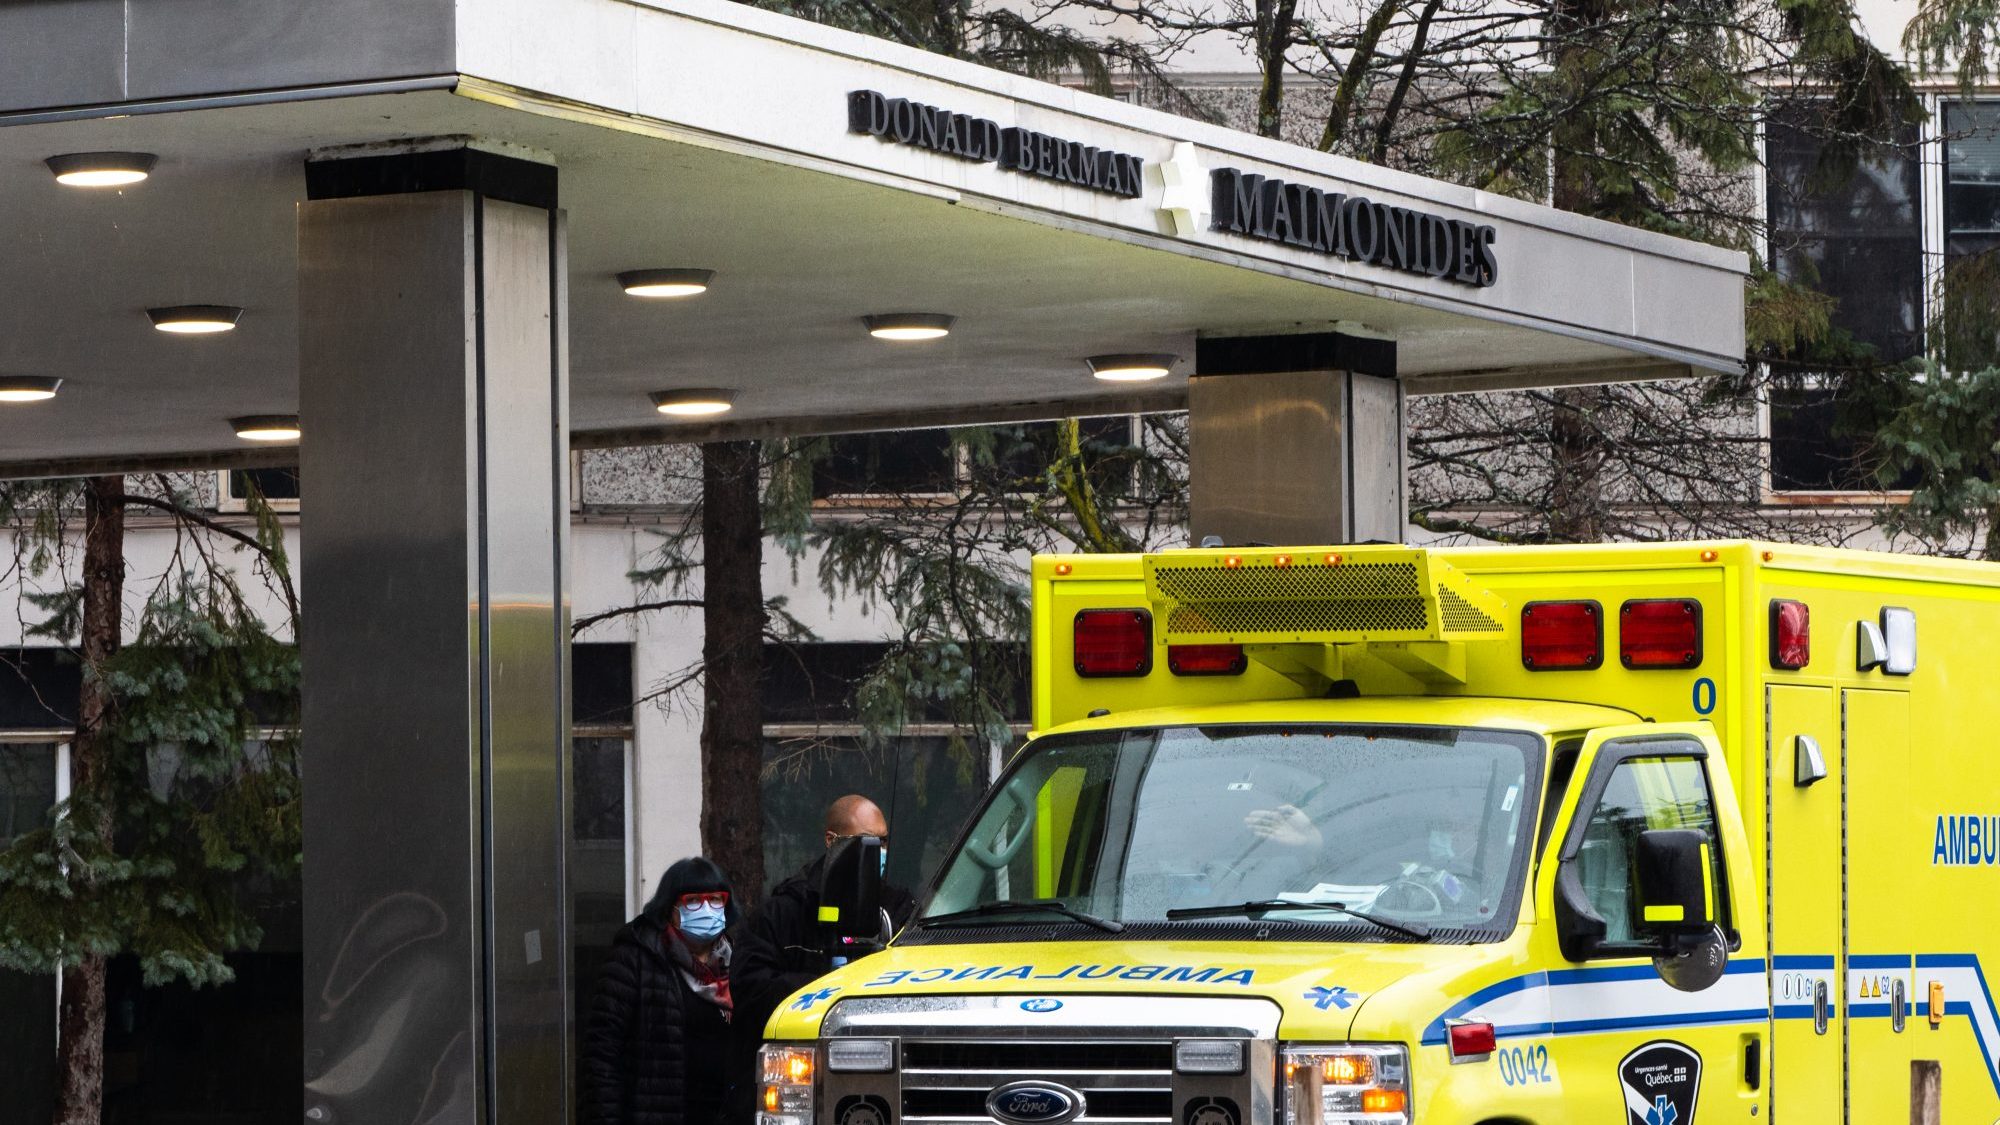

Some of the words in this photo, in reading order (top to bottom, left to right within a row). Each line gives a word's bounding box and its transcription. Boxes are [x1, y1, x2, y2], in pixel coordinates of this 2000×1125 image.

[849, 89, 1000, 162] DONALD
[1001, 127, 1144, 198] BERMAN
[1209, 168, 1498, 287] MAIMONIDES
[1933, 815, 2000, 865] AMBU
[1805, 978, 1813, 997] G1
[1881, 975, 1890, 995] G2
[1498, 1045, 1551, 1086] 0042
[1645, 1072, 1673, 1087] Québec
[1009, 1092, 1051, 1113] Ford
